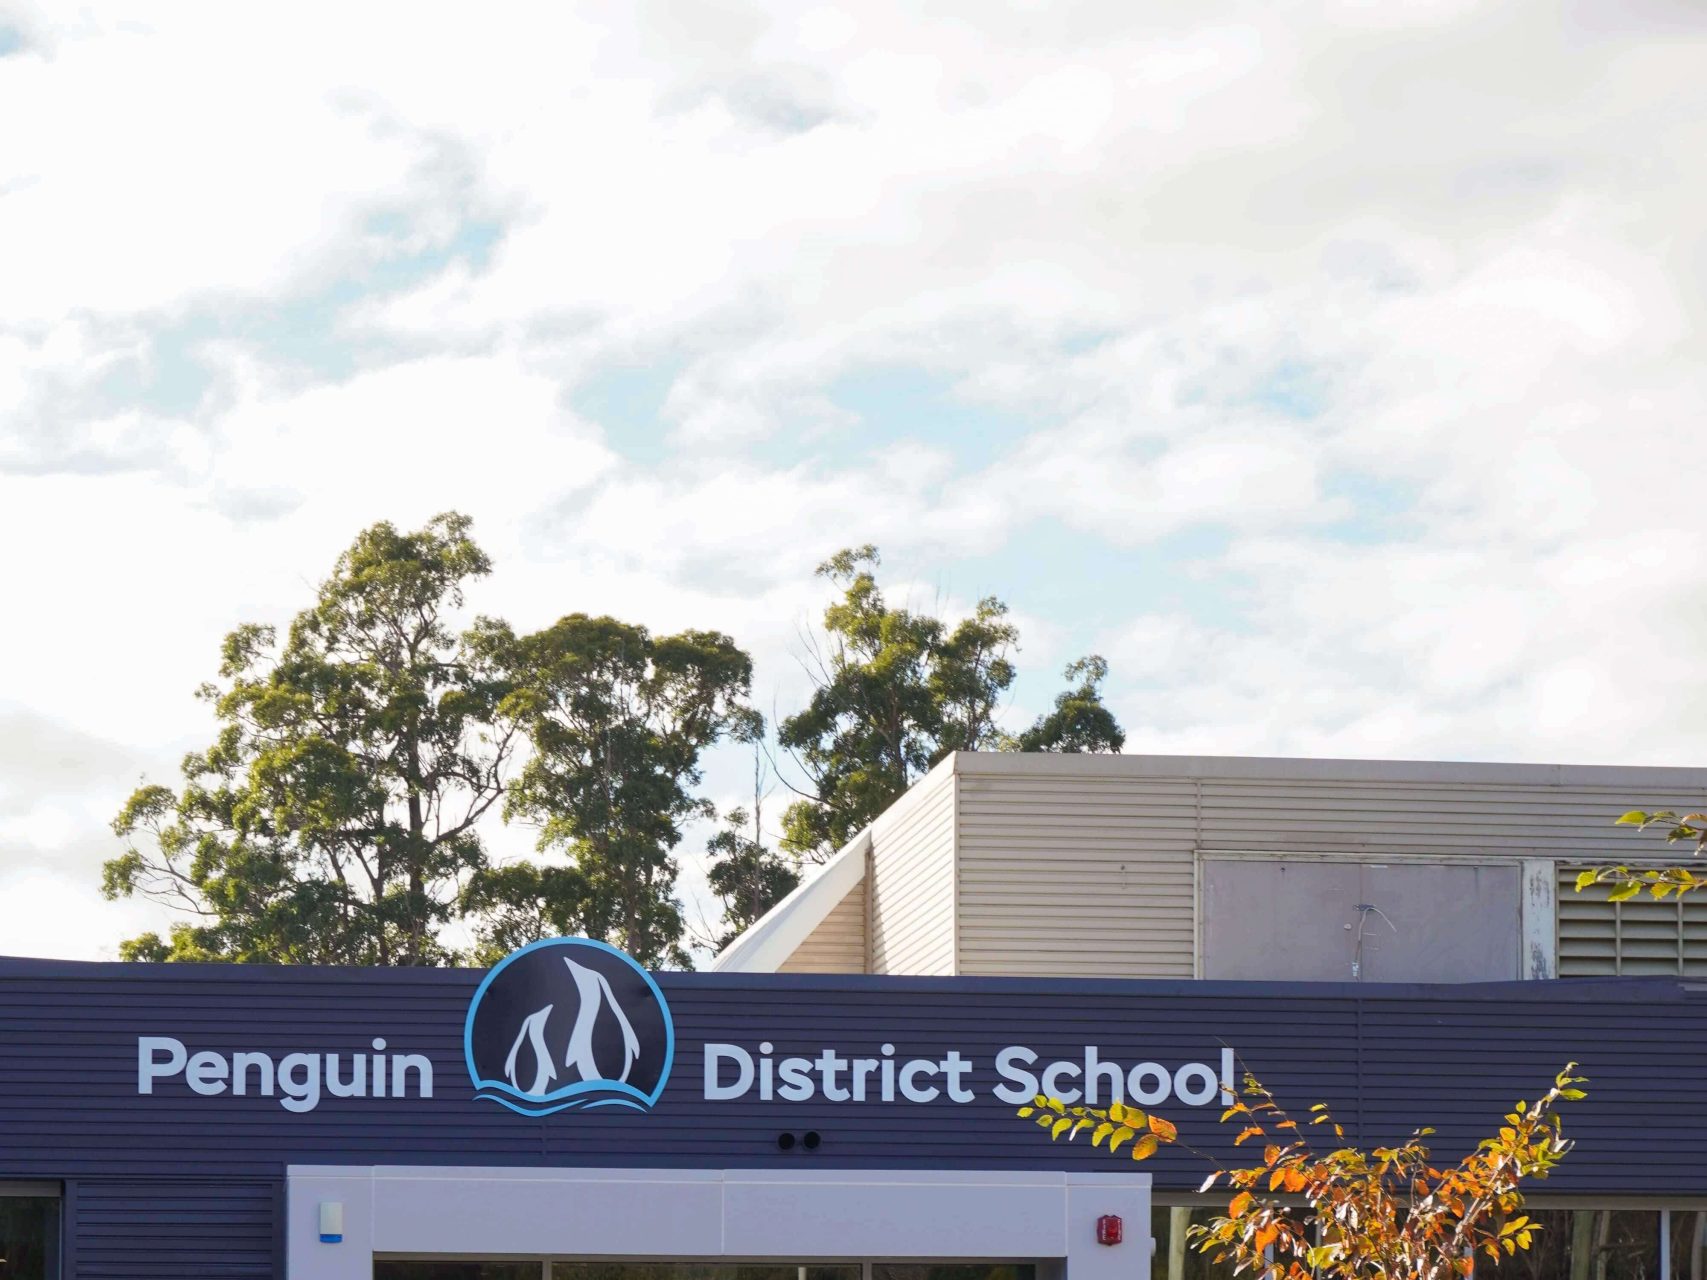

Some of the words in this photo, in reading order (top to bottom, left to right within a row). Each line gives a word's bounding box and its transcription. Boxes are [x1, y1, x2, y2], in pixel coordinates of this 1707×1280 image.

[138, 1036, 434, 1113] Penguin
[704, 1043, 976, 1105] District
[992, 1045, 1235, 1106] School
